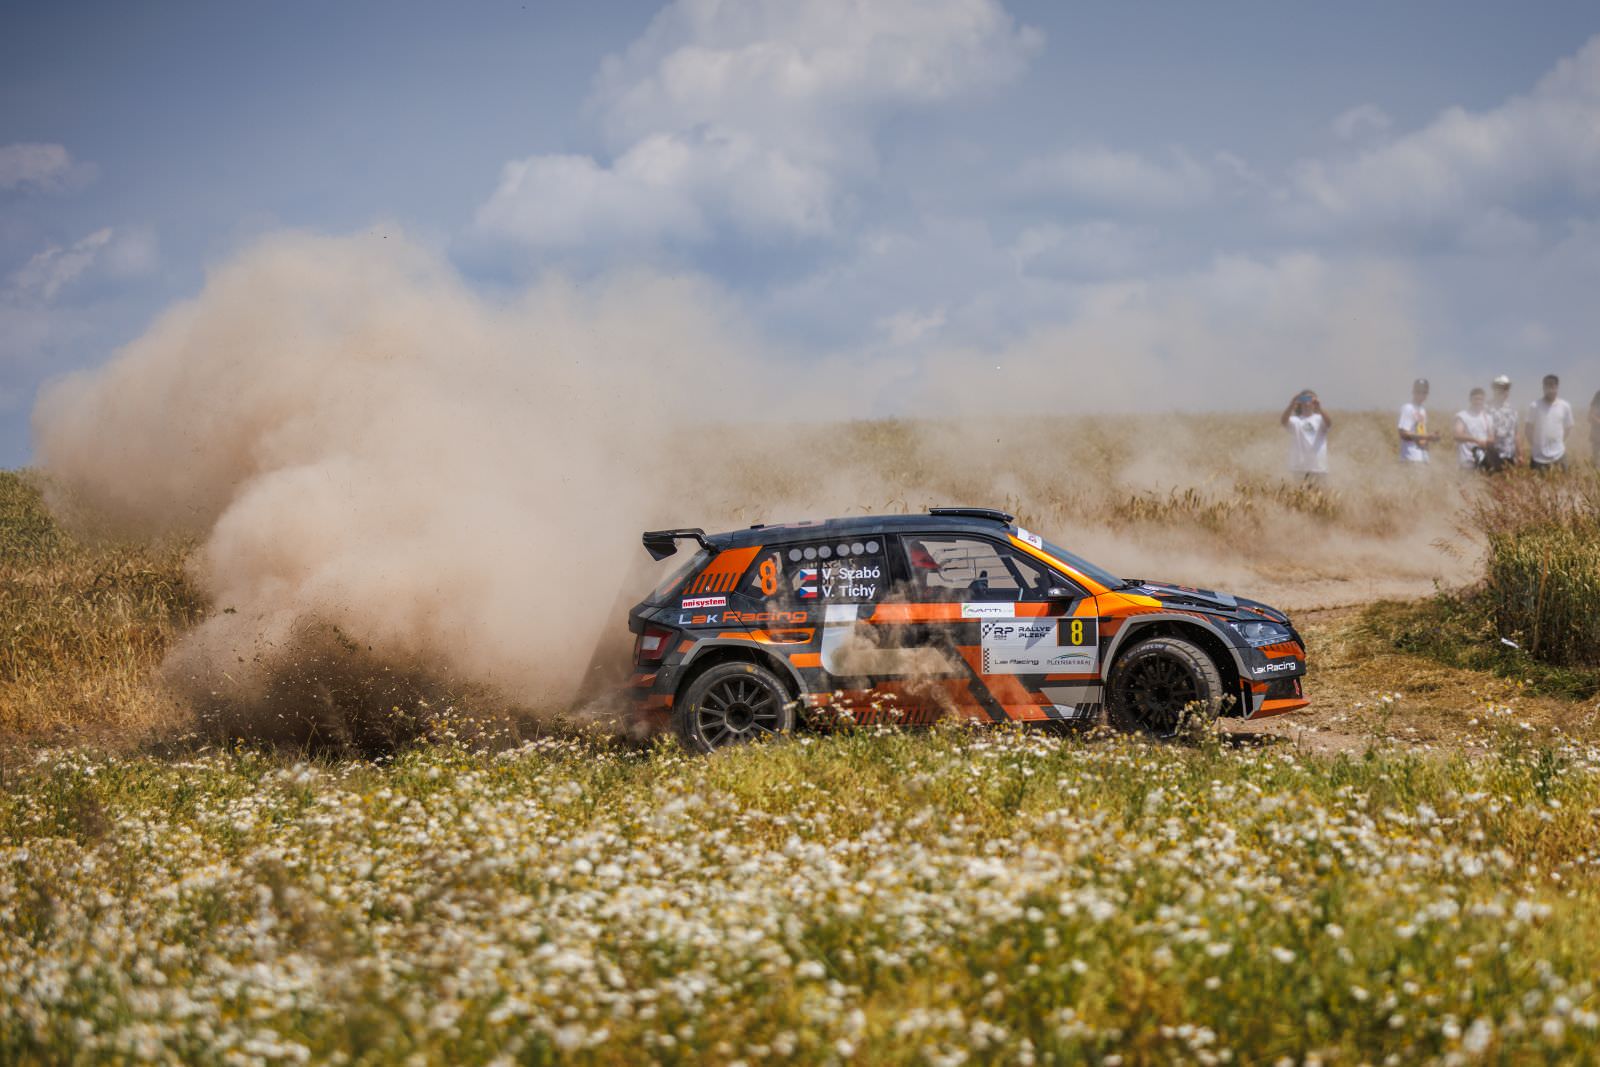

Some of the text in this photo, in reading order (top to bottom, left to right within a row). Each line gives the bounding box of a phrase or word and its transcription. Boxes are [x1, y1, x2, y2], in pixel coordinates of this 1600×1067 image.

[759, 560, 778, 597] 8
[822, 565, 881, 581] V. Szabó
[822, 583, 876, 600] V. Tichý
[678, 611, 809, 625] Lak Racing
[994, 626, 1014, 635] RP
[1071, 619, 1083, 646] 8
[1266, 661, 1296, 673] Racing
